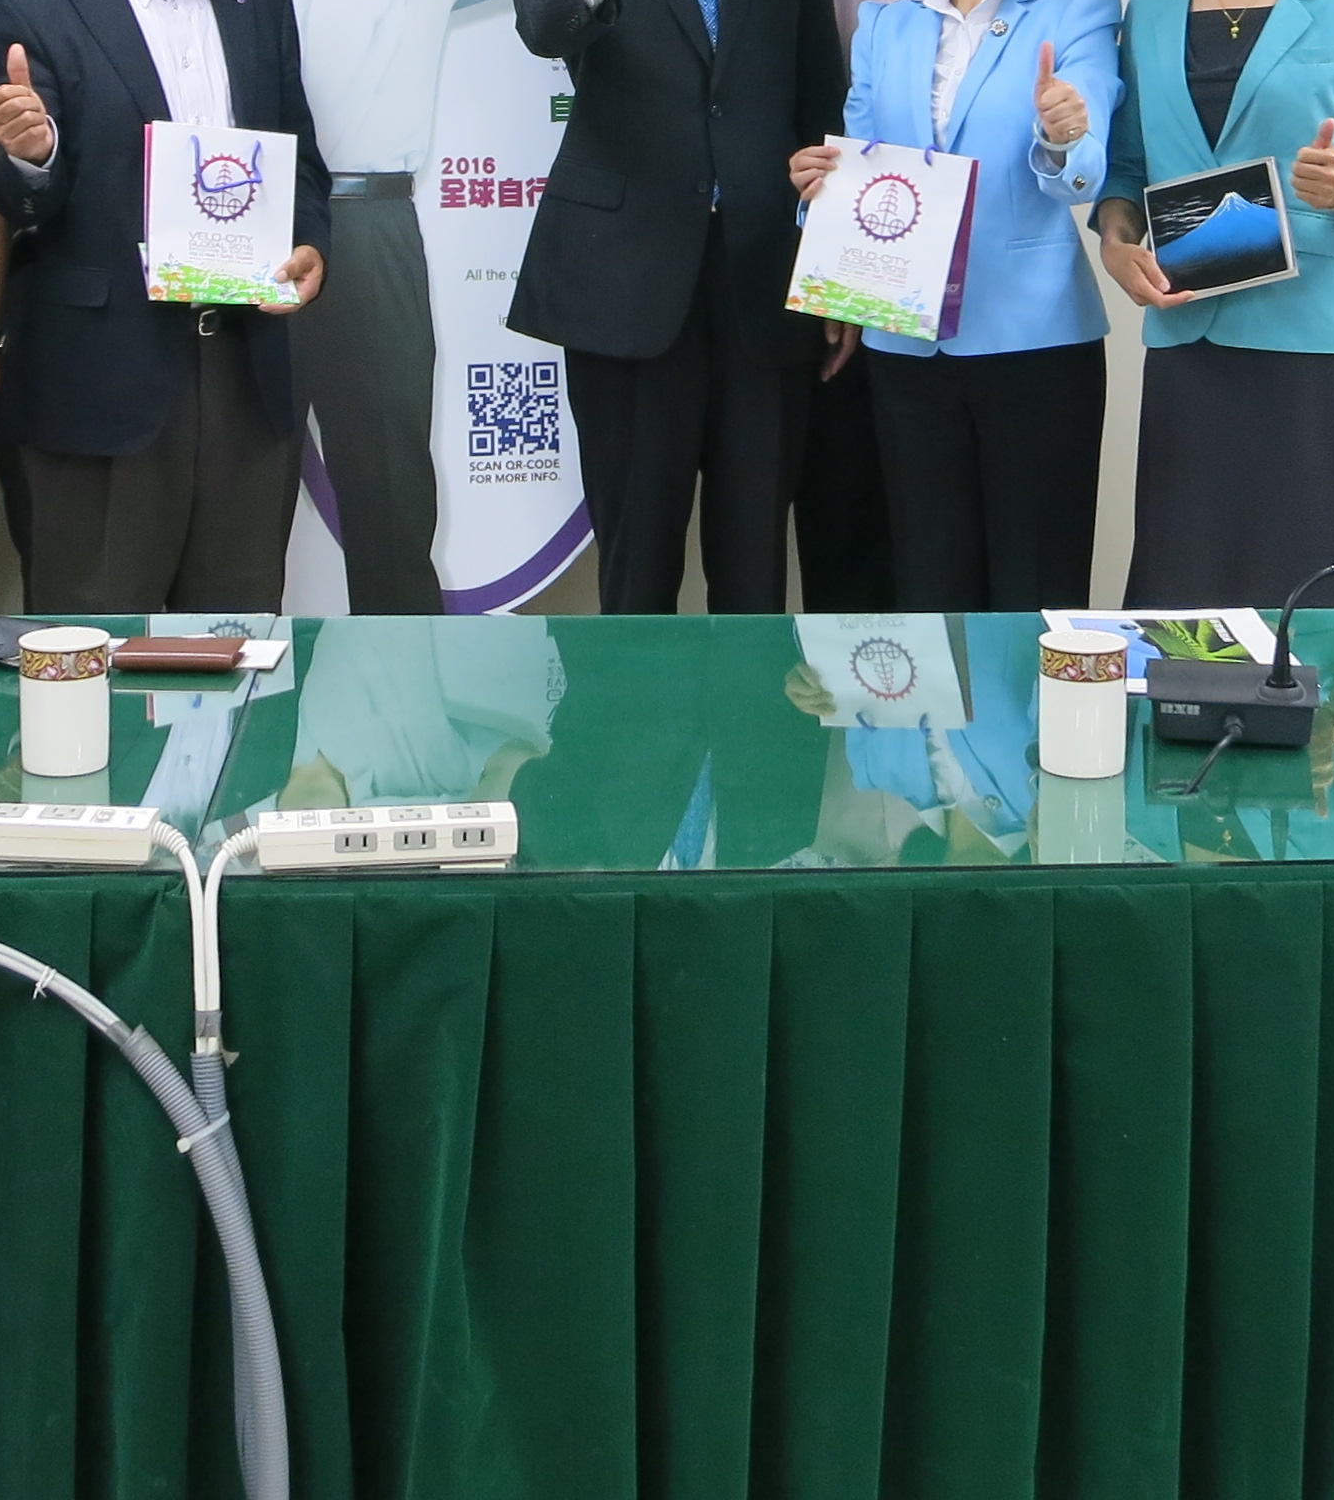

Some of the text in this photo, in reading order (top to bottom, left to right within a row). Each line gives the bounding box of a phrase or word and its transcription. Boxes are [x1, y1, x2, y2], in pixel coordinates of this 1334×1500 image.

[440, 157, 496, 175] 2016
[465, 269, 482, 281] All
[486, 269, 506, 281] the
[469, 458, 560, 472] SCAN QR-CODE
[469, 471, 561, 484] FOR MORE INFO.
